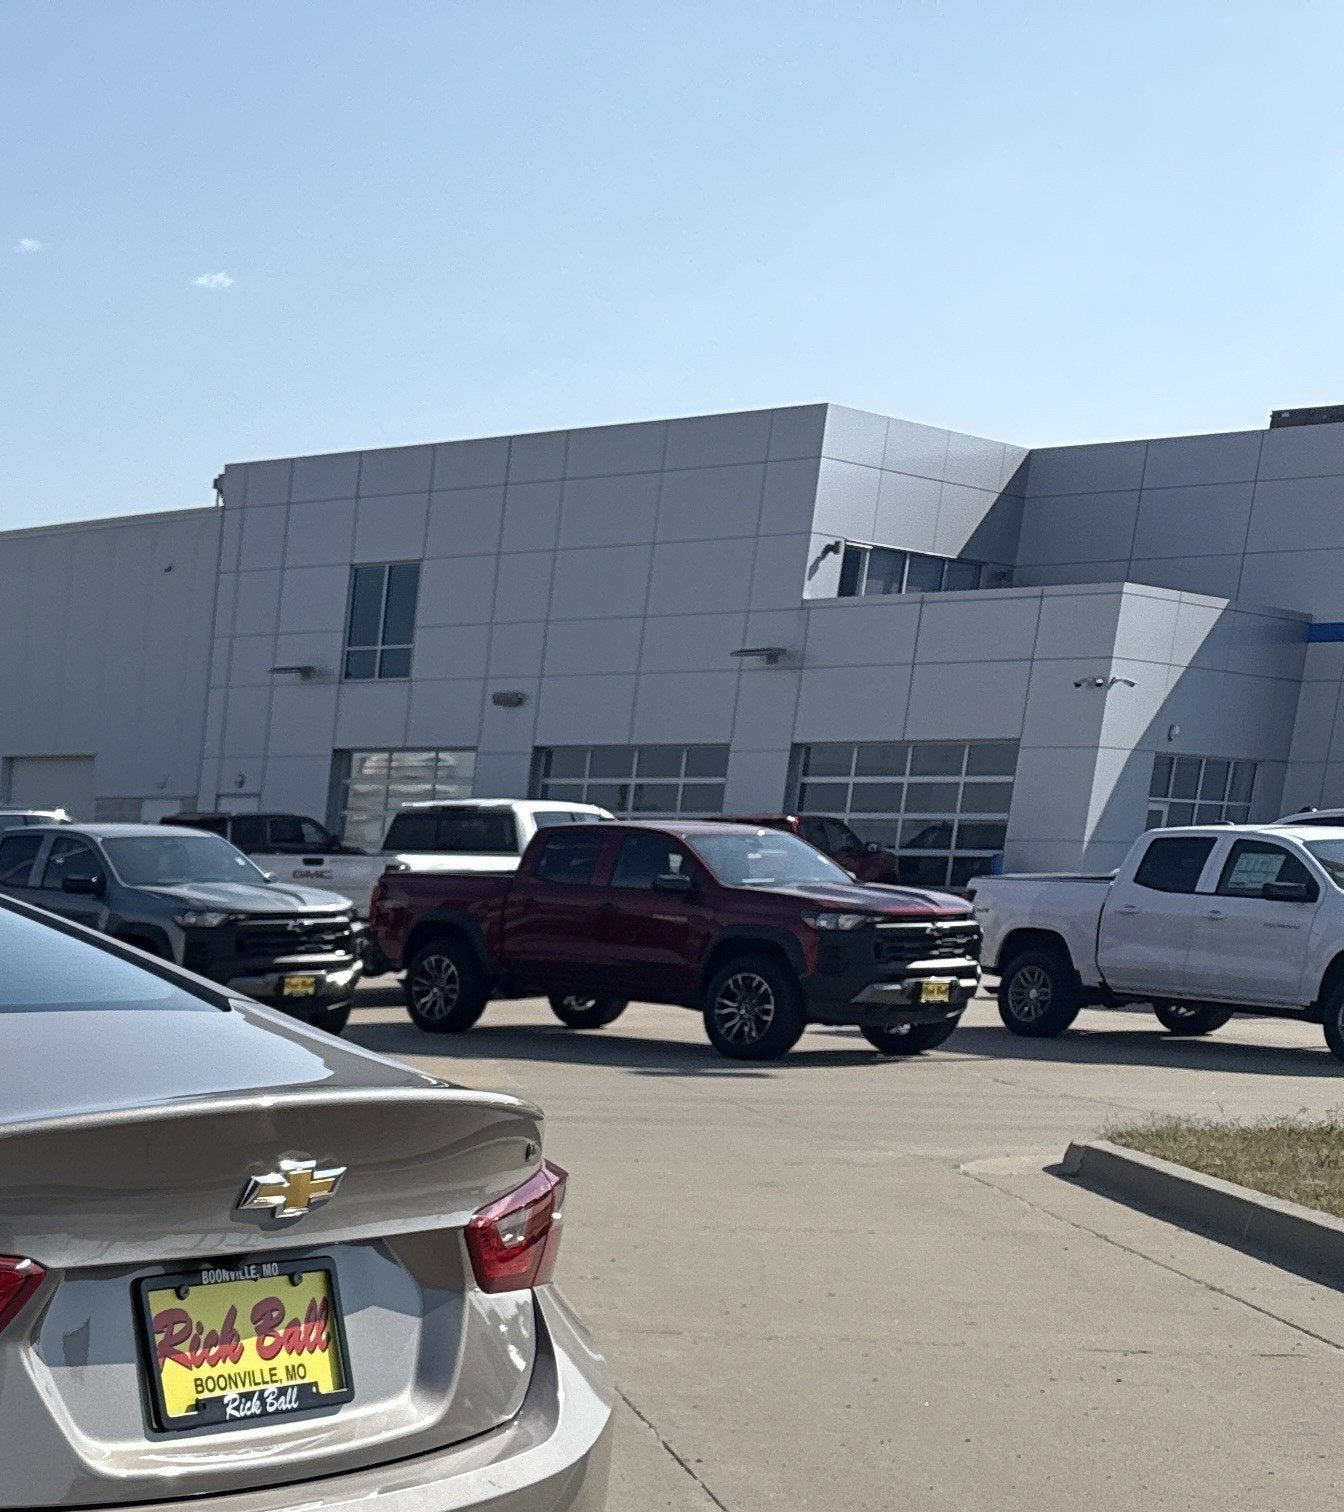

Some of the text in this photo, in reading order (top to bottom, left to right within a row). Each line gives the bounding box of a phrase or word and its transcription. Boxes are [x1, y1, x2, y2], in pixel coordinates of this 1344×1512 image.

[293, 869, 333, 880] GMC
[201, 1262, 280, 1285] BOONVILLE, MO
[152, 1296, 332, 1375] Rick Ball
[193, 1363, 308, 1395] BOONVILLE, MO
[223, 1388, 299, 1421] Rick Ball
